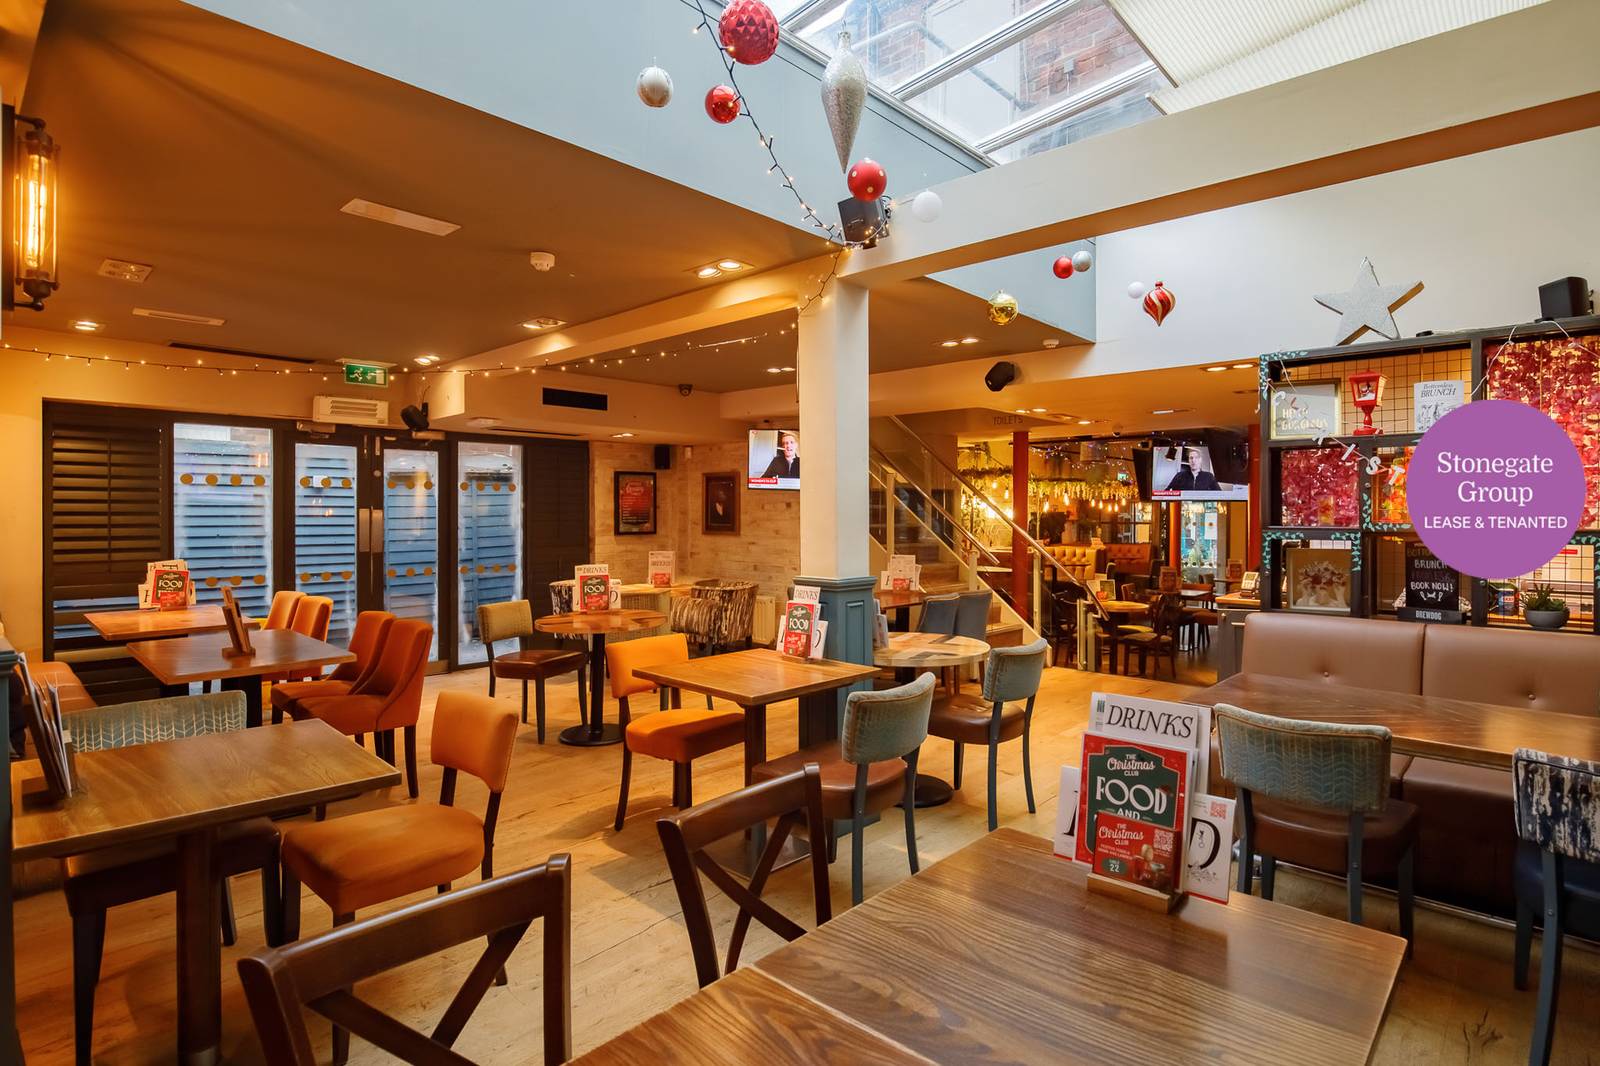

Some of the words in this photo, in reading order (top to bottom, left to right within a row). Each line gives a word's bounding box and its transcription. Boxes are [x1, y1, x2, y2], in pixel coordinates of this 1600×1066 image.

[1421, 388, 1456, 398] BRUNCH
[993, 415, 1024, 425] TOILETS
[159, 580, 182, 588] FOOD
[584, 584, 605, 593] FOOD
[1410, 581, 1430, 590] BOOK
[1432, 582, 1453, 592] NOW!
[794, 588, 818, 601] DRINKS
[1416, 610, 1442, 620] BREWDOG
[1106, 704, 1193, 738] DRINKS
[1107, 757, 1156, 771] Christmas
[1096, 776, 1167, 814] FOOD
[1117, 808, 1141, 820] AND
[1098, 826, 1145, 841] Christmas
[1109, 863, 1120, 872] 22
